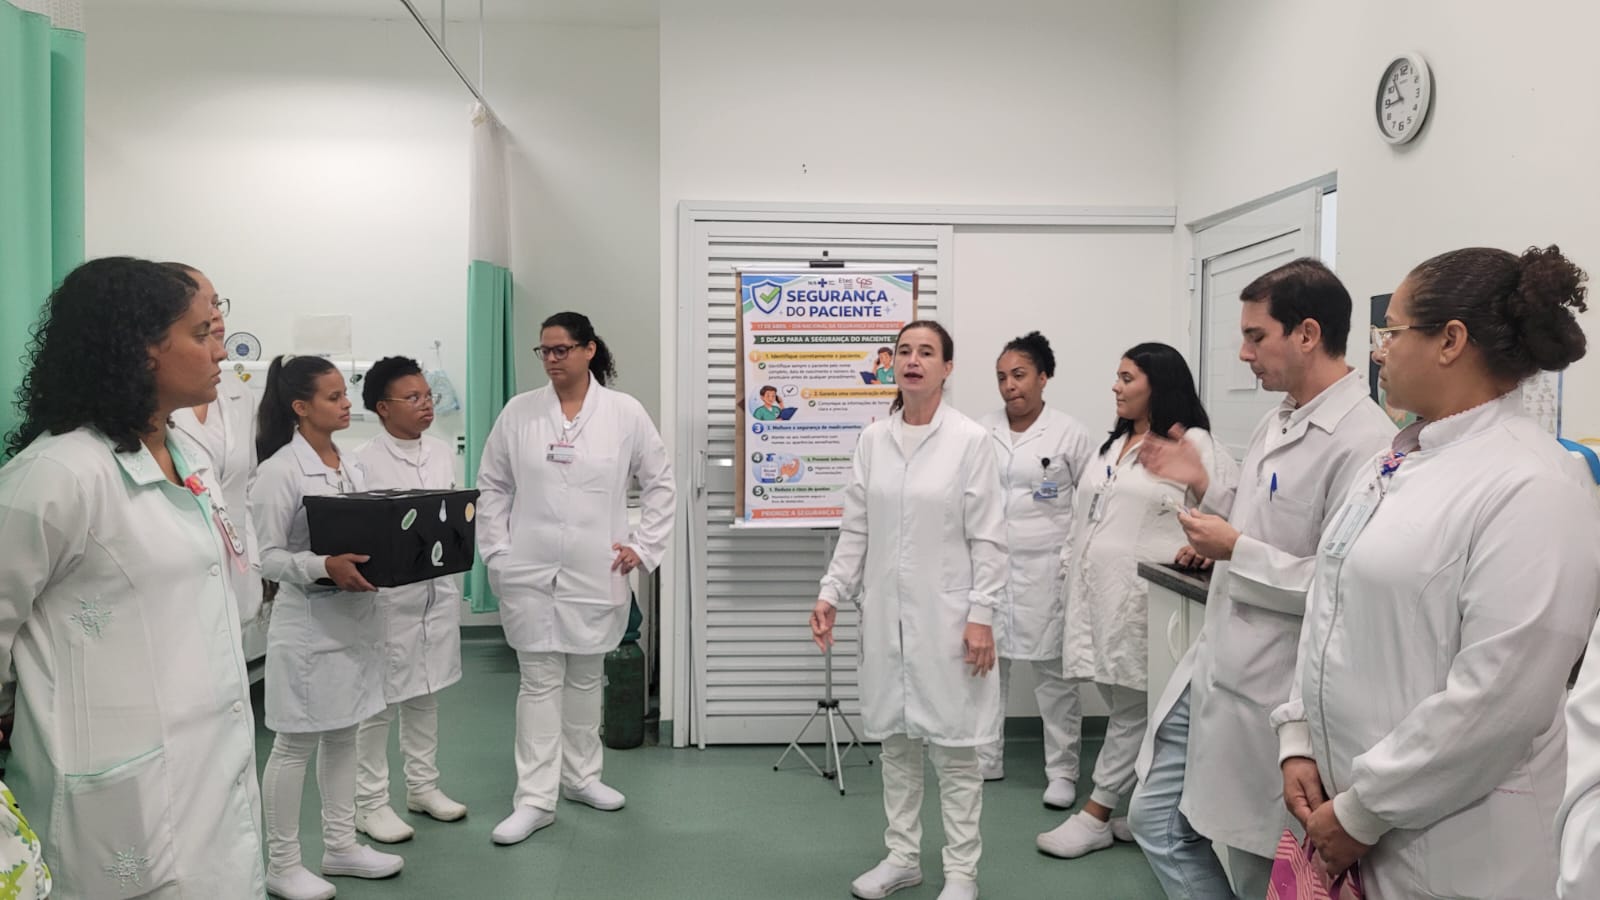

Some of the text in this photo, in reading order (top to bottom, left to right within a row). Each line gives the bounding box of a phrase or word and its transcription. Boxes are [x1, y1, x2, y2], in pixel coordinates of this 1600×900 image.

[1400, 64, 1408, 76] 12
[1414, 76, 1419, 84] 2
[1416, 88, 1420, 98] 3
[1385, 98, 1390, 109] 9
[1392, 120, 1396, 128] 7
[1406, 116, 1412, 124] 5
[1398, 121, 1404, 131] 6
[786, 290, 888, 304] SEGURANÇA
[786, 306, 882, 317] DO PACIENTE
[755, 487, 761, 495] 5
